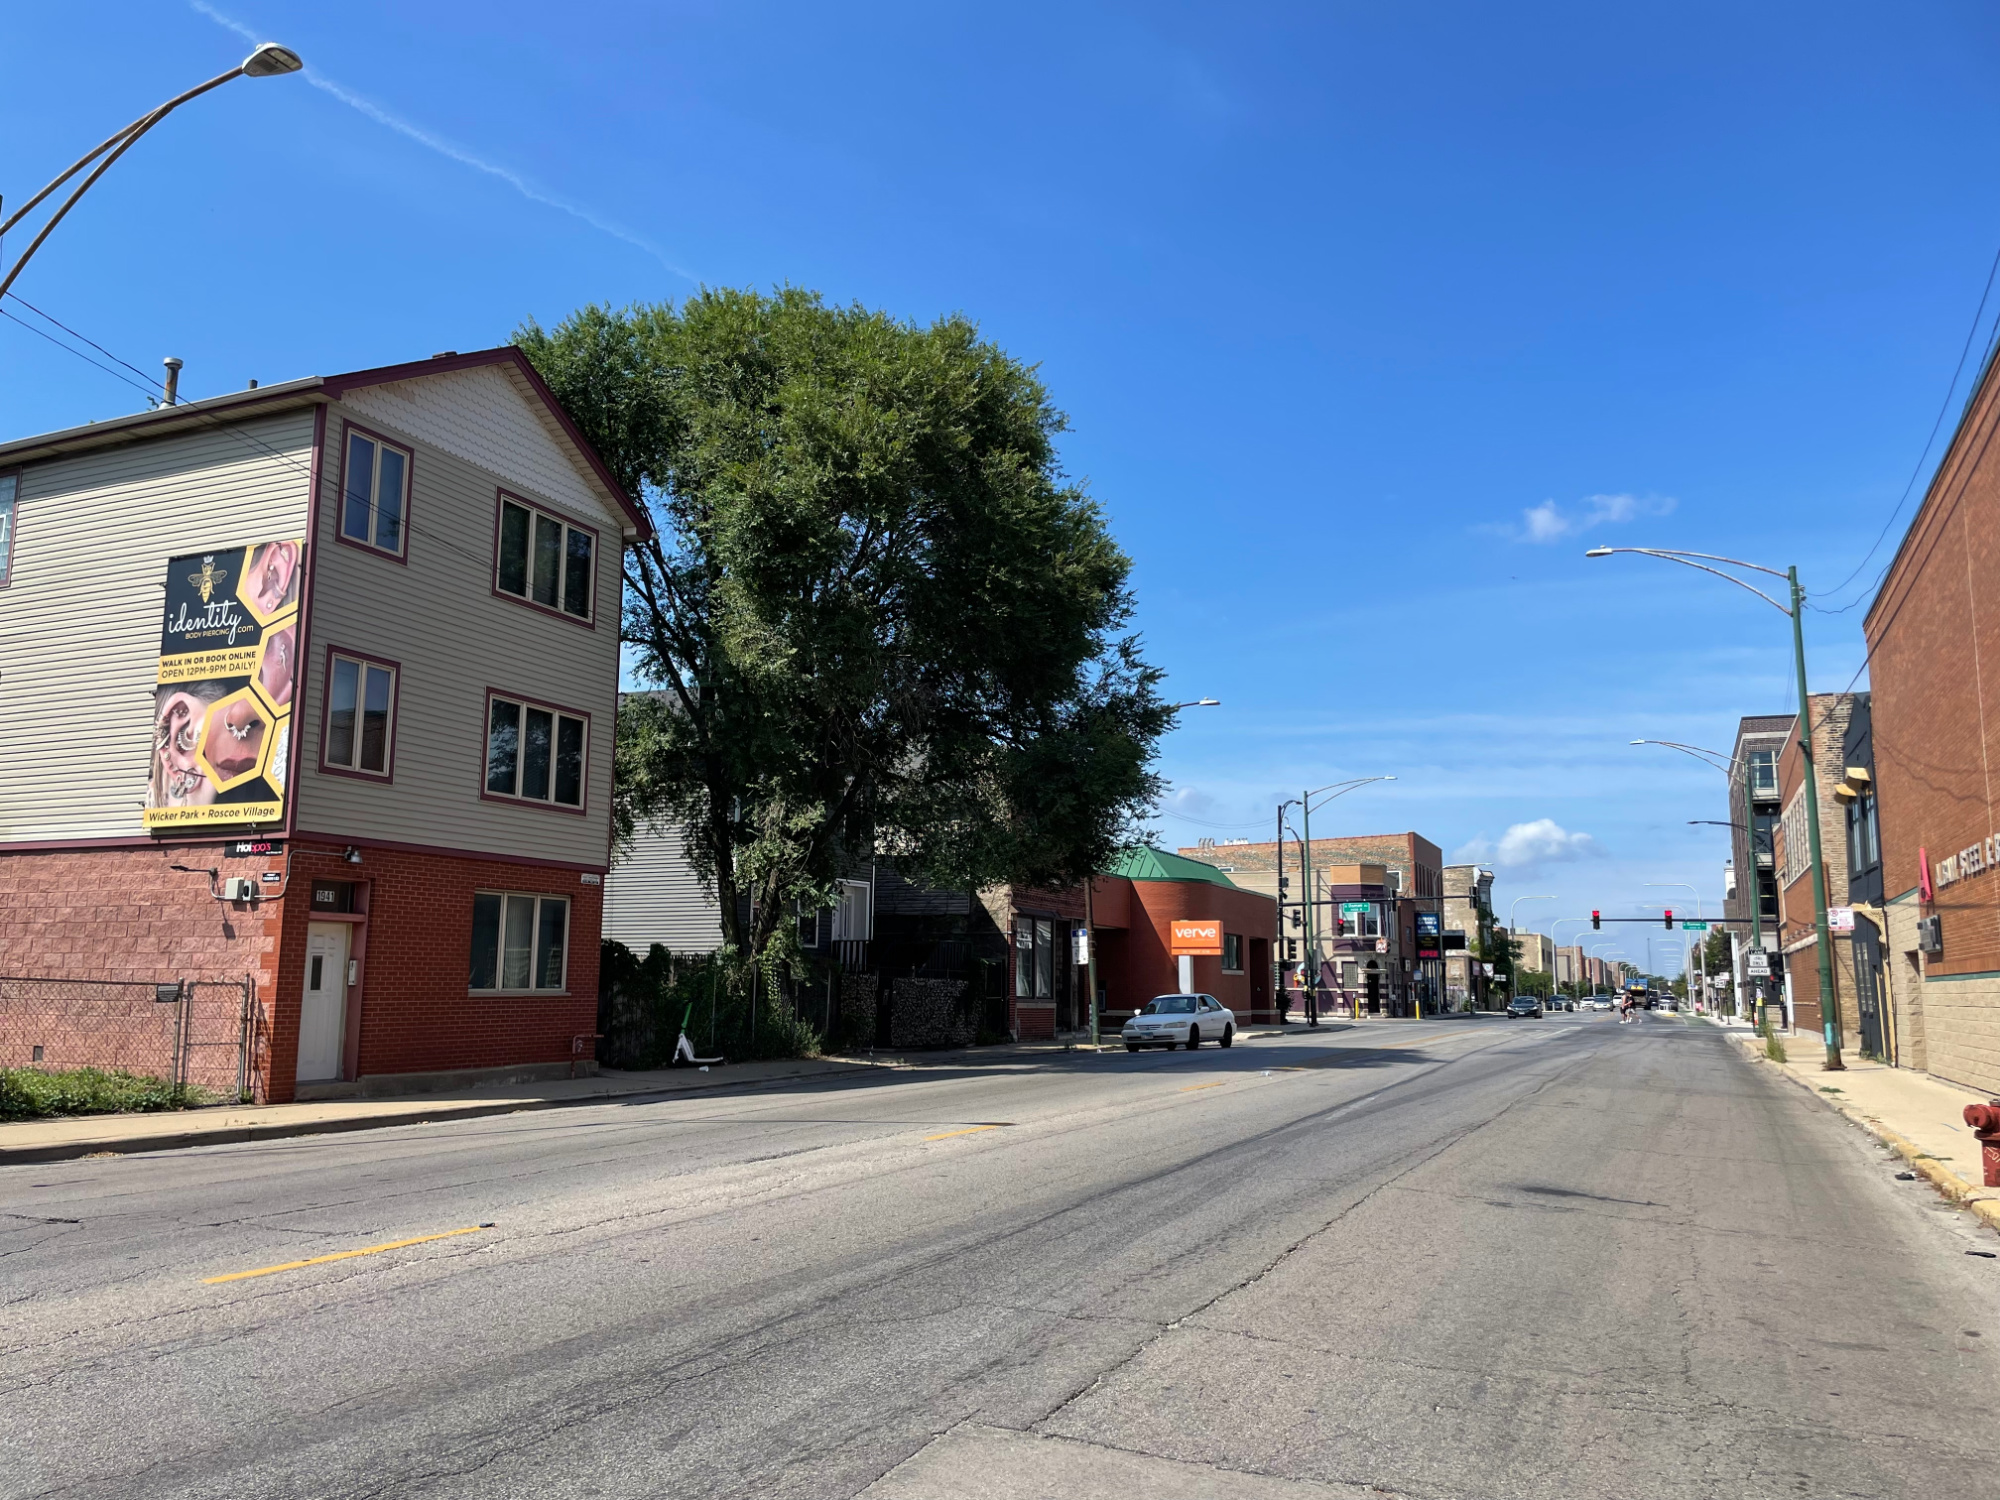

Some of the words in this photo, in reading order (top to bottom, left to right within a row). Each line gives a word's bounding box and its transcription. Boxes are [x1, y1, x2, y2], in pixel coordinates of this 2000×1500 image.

[169, 600, 242, 646] identity
[202, 628, 230, 637] PIERCING
[162, 659, 183, 668] WALK
[184, 657, 192, 665] IN
[205, 654, 227, 663] BOOK
[228, 651, 256, 660] ONLINE
[161, 669, 185, 678] OPEN
[187, 664, 226, 676] 12PM-9PM
[229, 661, 256, 671] DAILY!
[149, 811, 178, 822] Wicker
[180, 810, 199, 820] Park
[208, 809, 240, 818] Roscoe
[243, 806, 275, 817] Village
[318, 891, 334, 902] 1941
[1175, 928, 1216, 938] verve
